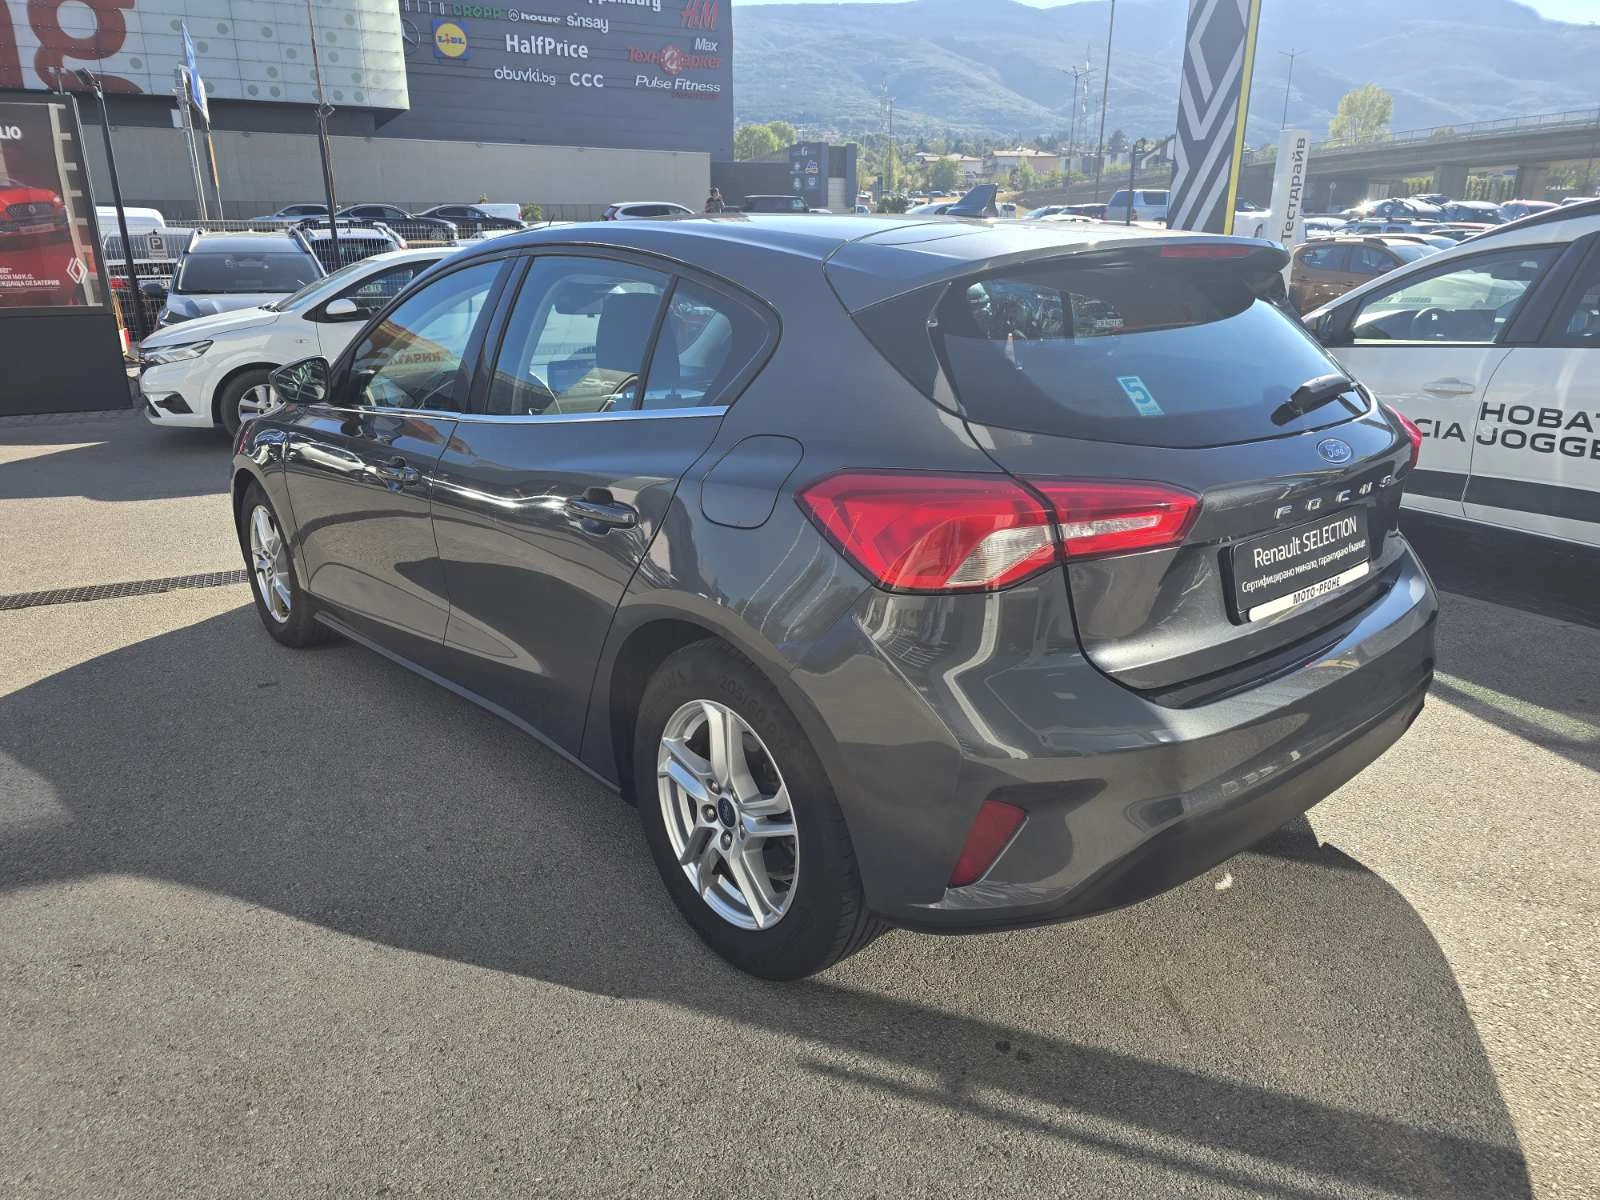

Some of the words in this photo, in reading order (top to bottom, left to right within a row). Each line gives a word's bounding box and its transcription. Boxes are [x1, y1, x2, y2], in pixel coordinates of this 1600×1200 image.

[566, 12, 609, 34] sinsay
[505, 33, 589, 58] HalfPrice
[695, 38, 718, 52] Max
[494, 66, 556, 86] obuvki.bg
[569, 72, 604, 87] CCC
[635, 75, 672, 89] Pulse
[674, 78, 721, 93] Fitness
[0, 126, 21, 139] LIO
[1280, 137, 1306, 242] Тестдрайв
[1414, 413, 1466, 442] CIA
[1480, 402, 1600, 433] НОВА
[1274, 474, 1392, 520] FOCUS
[1253, 536, 1301, 569] Renault
[1302, 515, 1358, 553] SELECTION
